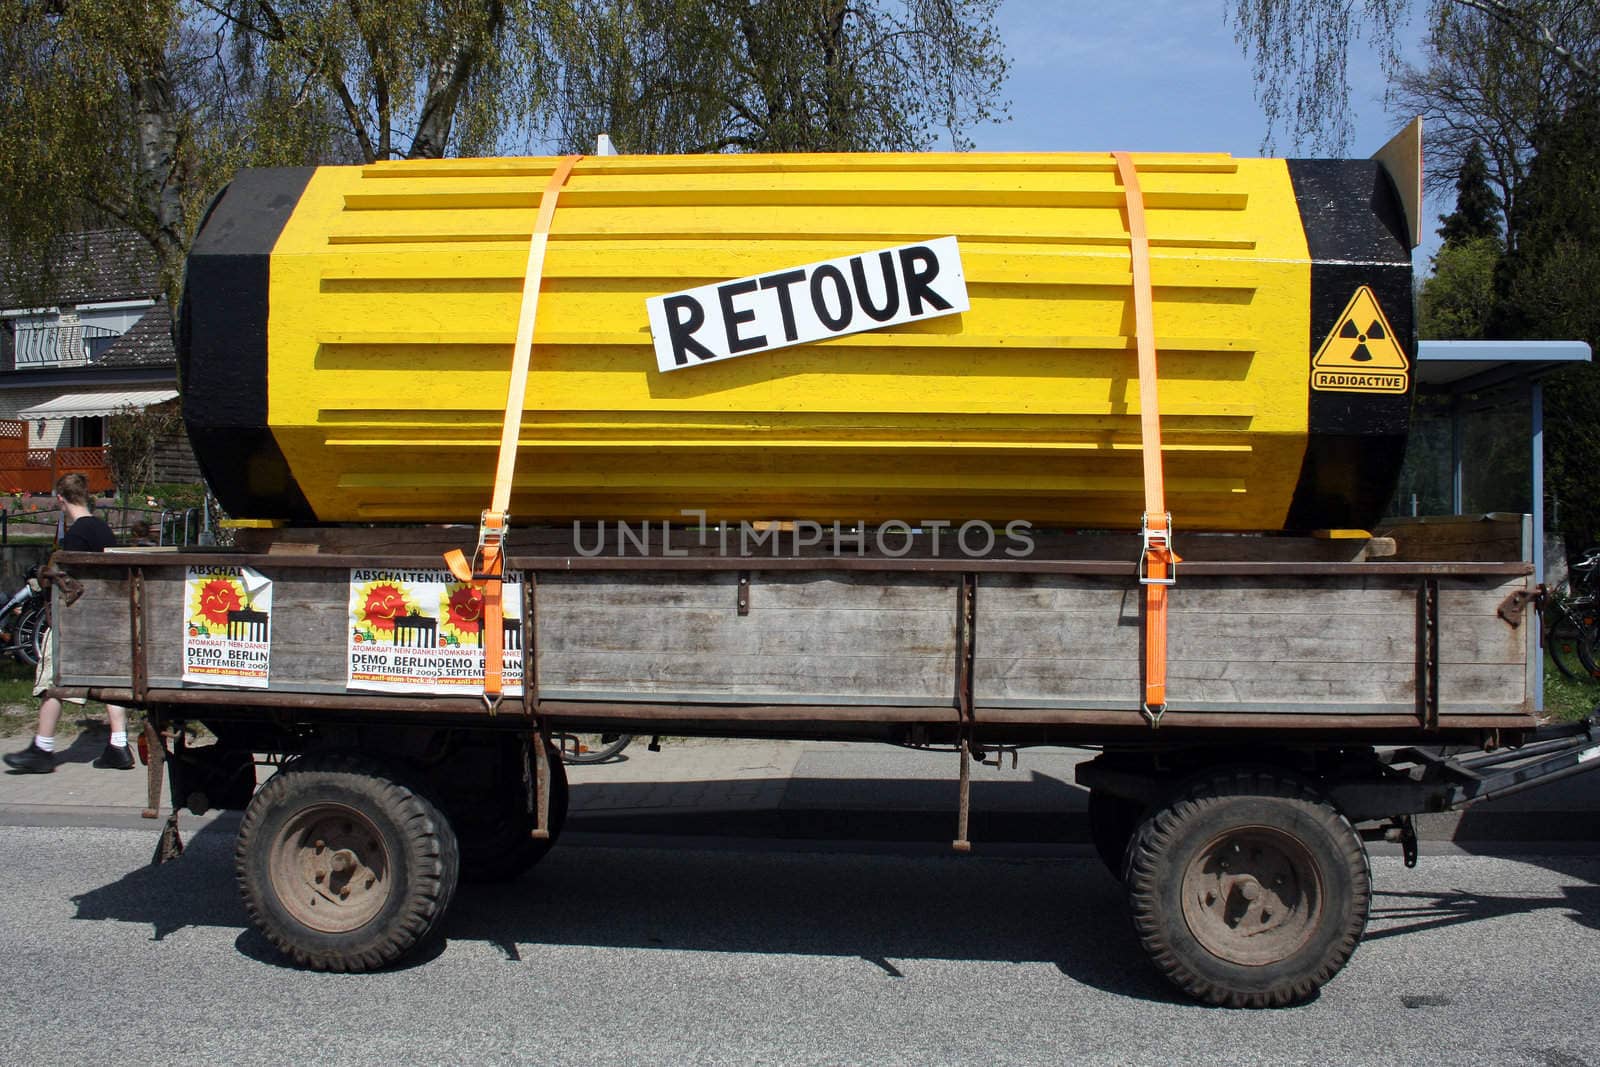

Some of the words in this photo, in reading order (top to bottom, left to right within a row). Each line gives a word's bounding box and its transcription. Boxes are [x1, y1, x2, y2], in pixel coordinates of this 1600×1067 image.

[663, 246, 954, 365] RETOUR
[1320, 375, 1400, 387] RADIOACTIVE
[188, 639, 226, 647] ATOMKRAFT
[188, 647, 222, 659] DEMO
[228, 650, 268, 661] BERLIN
[352, 645, 392, 653] ATOMKRAFT
[352, 653, 388, 665] DEMO
[394, 656, 437, 667] BERLIN
[437, 658, 472, 668] DEMO
[416, 669, 437, 677] 2009
